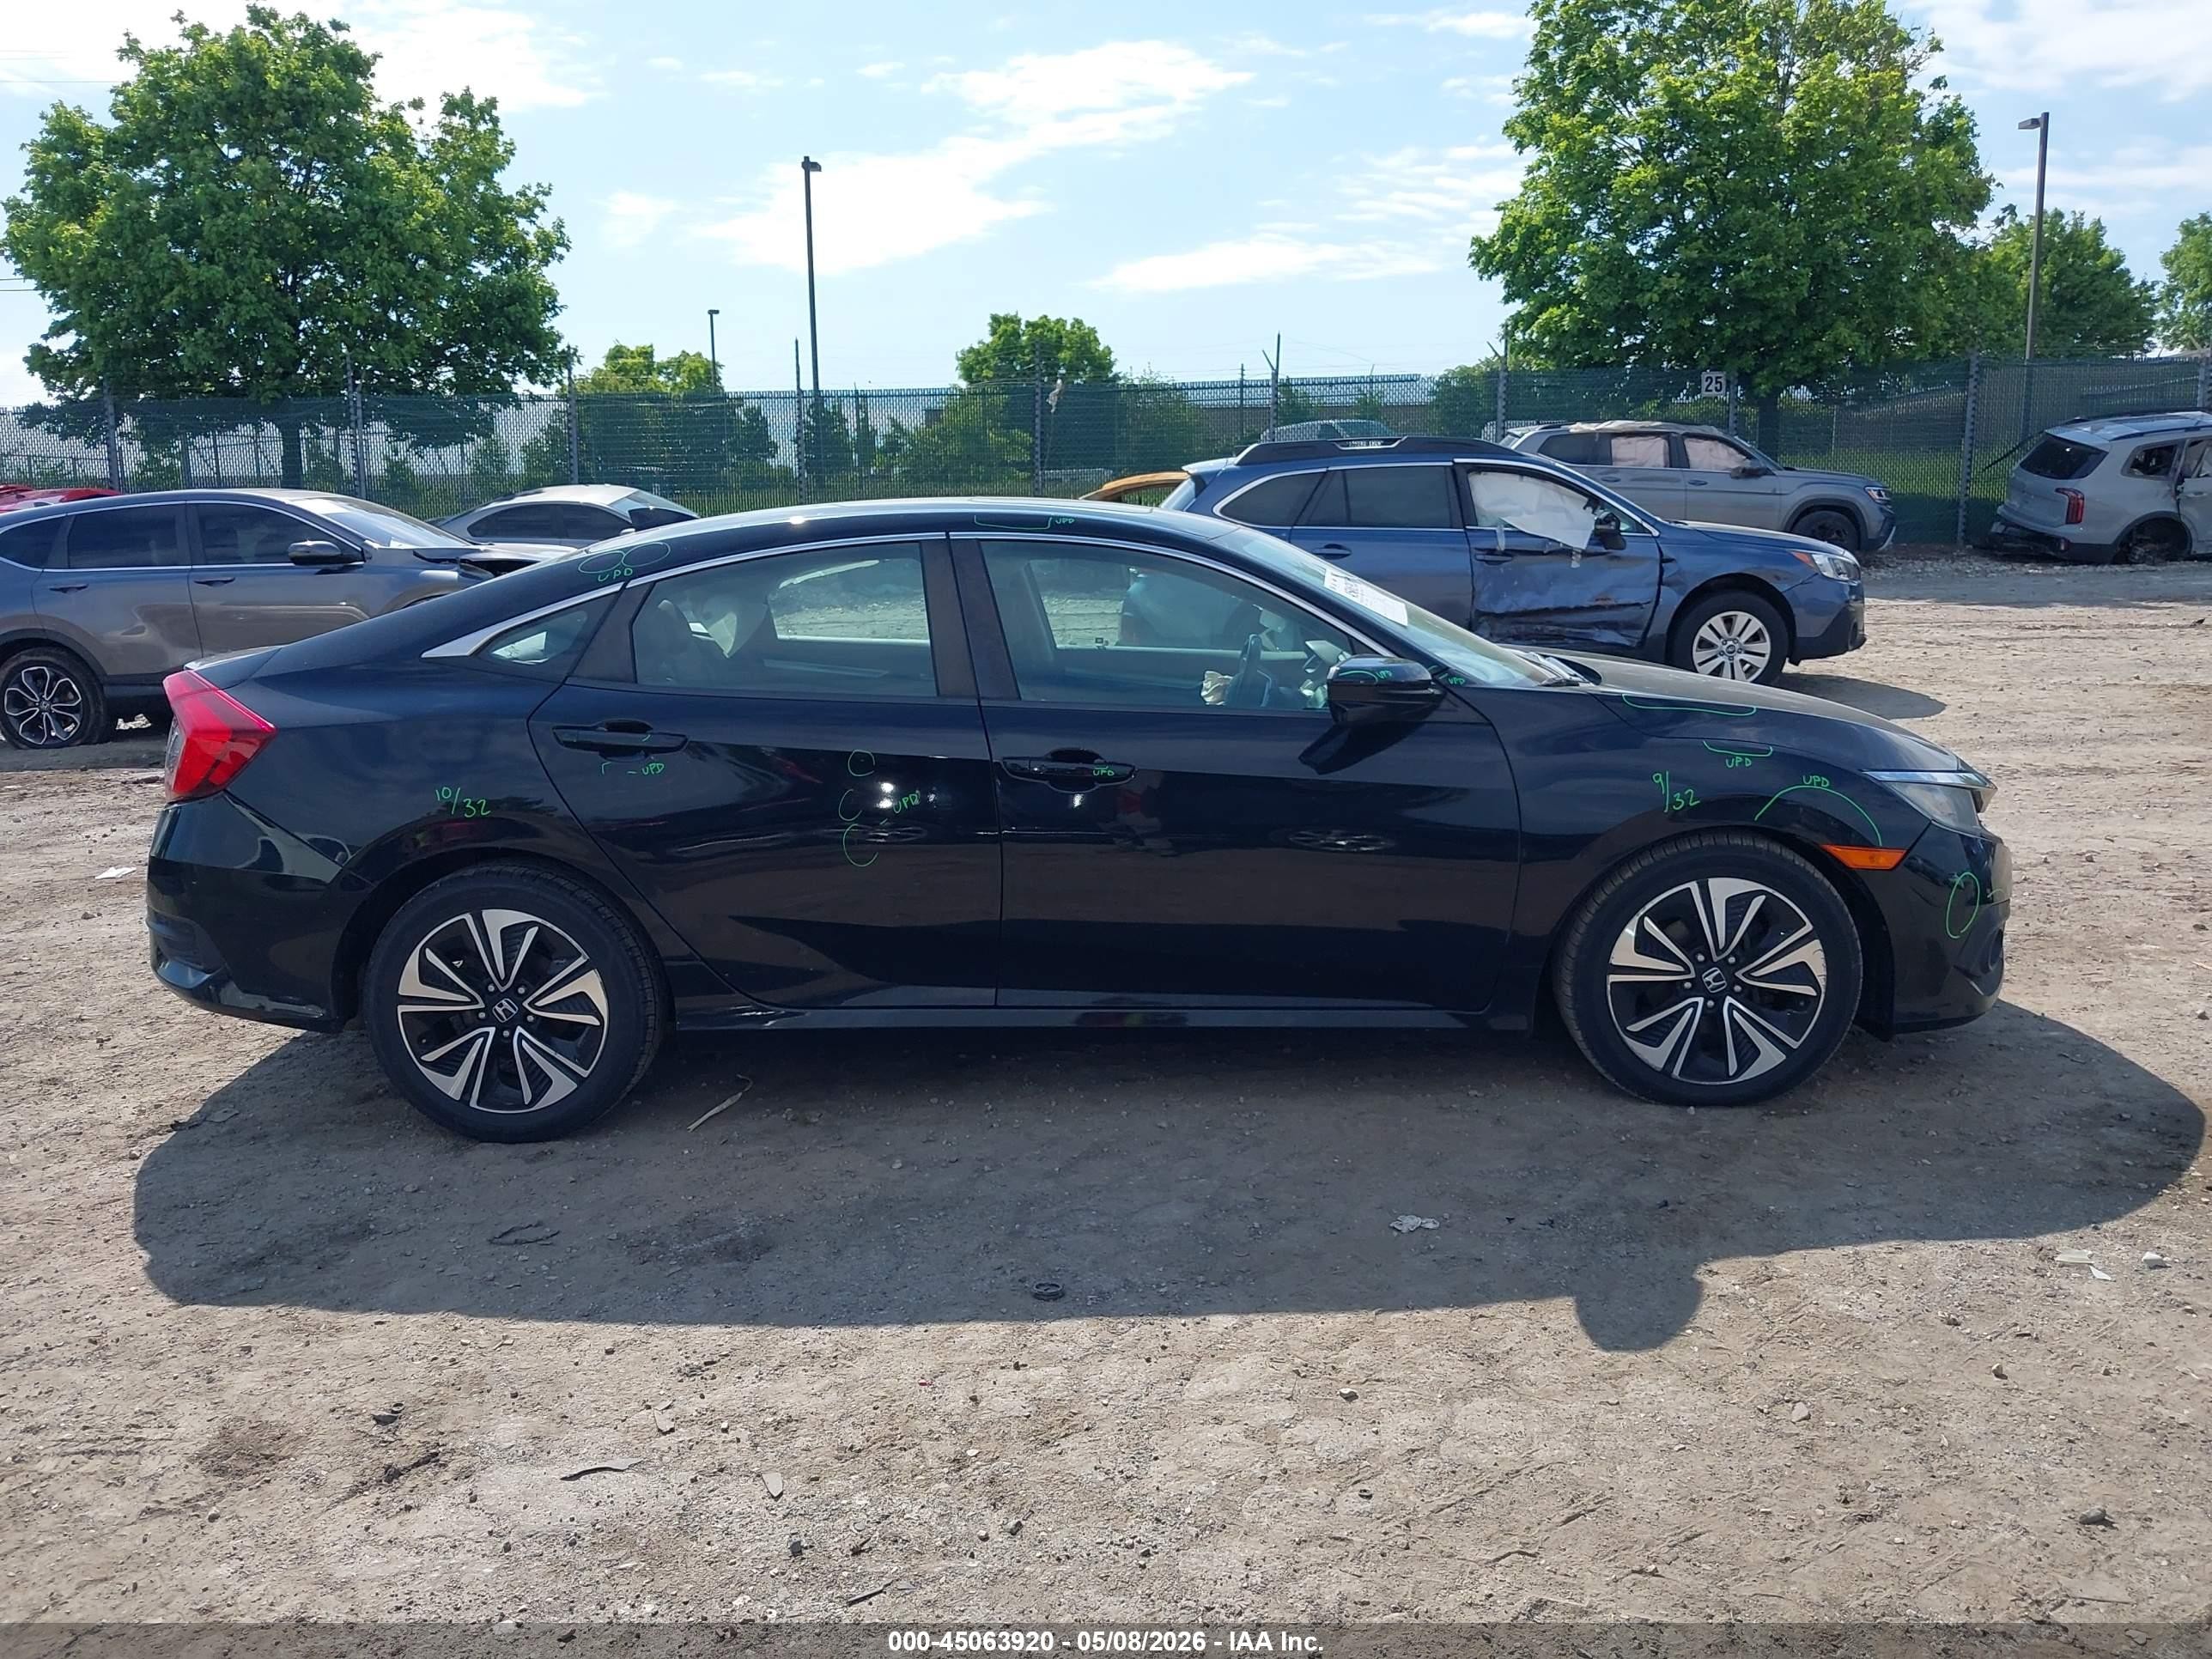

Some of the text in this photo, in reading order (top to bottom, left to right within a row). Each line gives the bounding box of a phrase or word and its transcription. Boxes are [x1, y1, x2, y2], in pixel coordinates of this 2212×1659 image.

[1705, 375, 1723, 392] 25
[597, 568, 634, 582] UPD
[641, 763, 665, 775] UPD
[1725, 757, 1753, 769] UPD
[1802, 775, 1830, 787] UPD
[435, 787, 491, 817] 10/32
